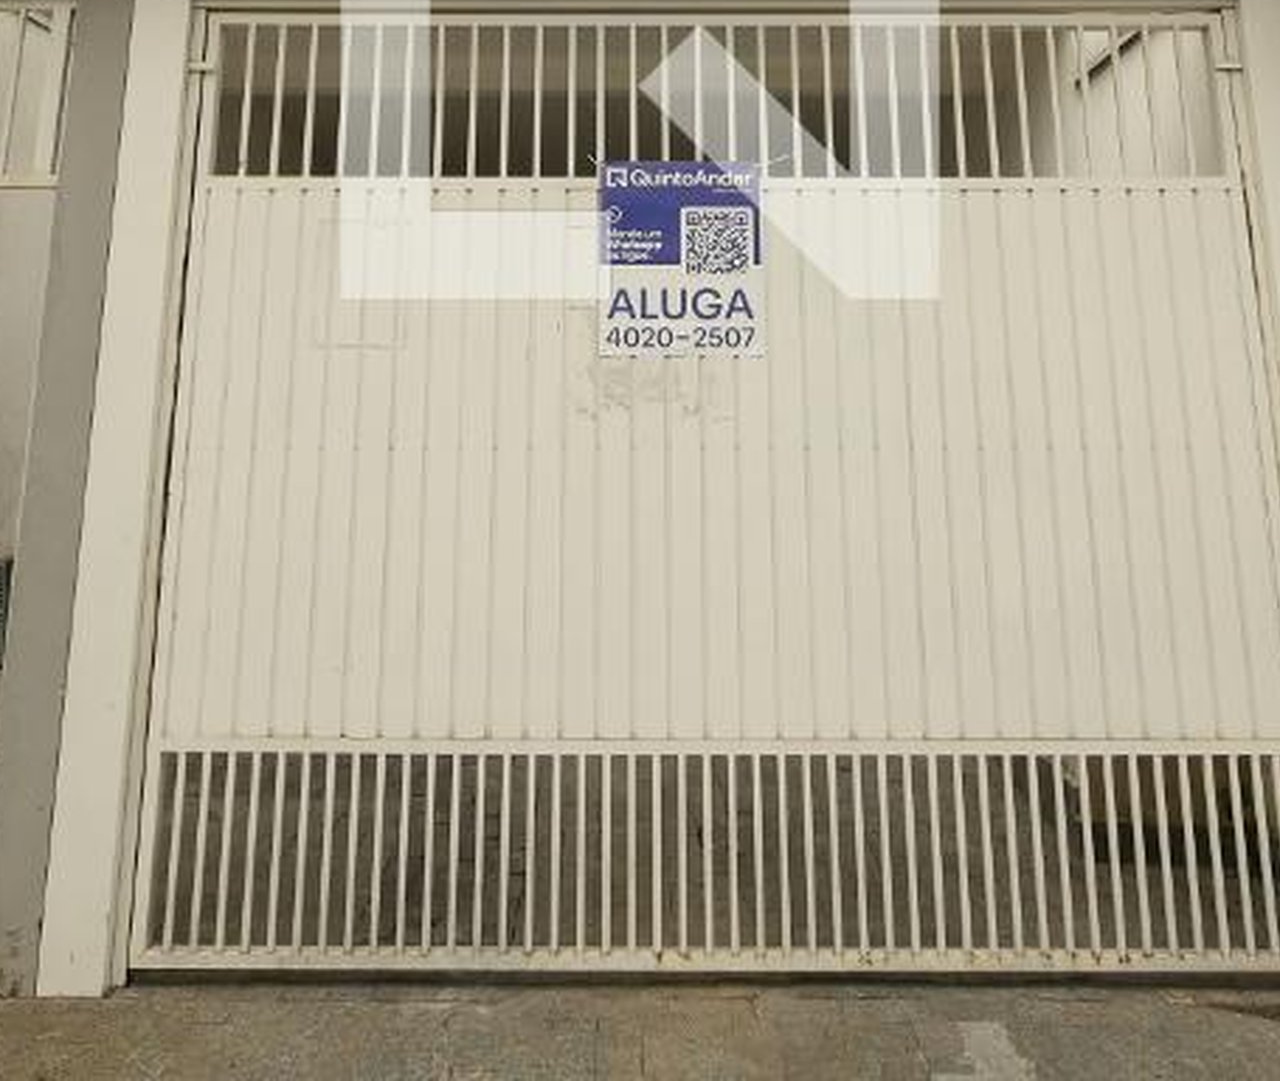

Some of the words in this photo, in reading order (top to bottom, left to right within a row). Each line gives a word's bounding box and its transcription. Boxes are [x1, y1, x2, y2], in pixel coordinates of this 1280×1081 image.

[630, 169, 752, 189] QuintoAndar
[607, 288, 754, 320] ALUGA
[606, 326, 756, 349] 4020-2507
